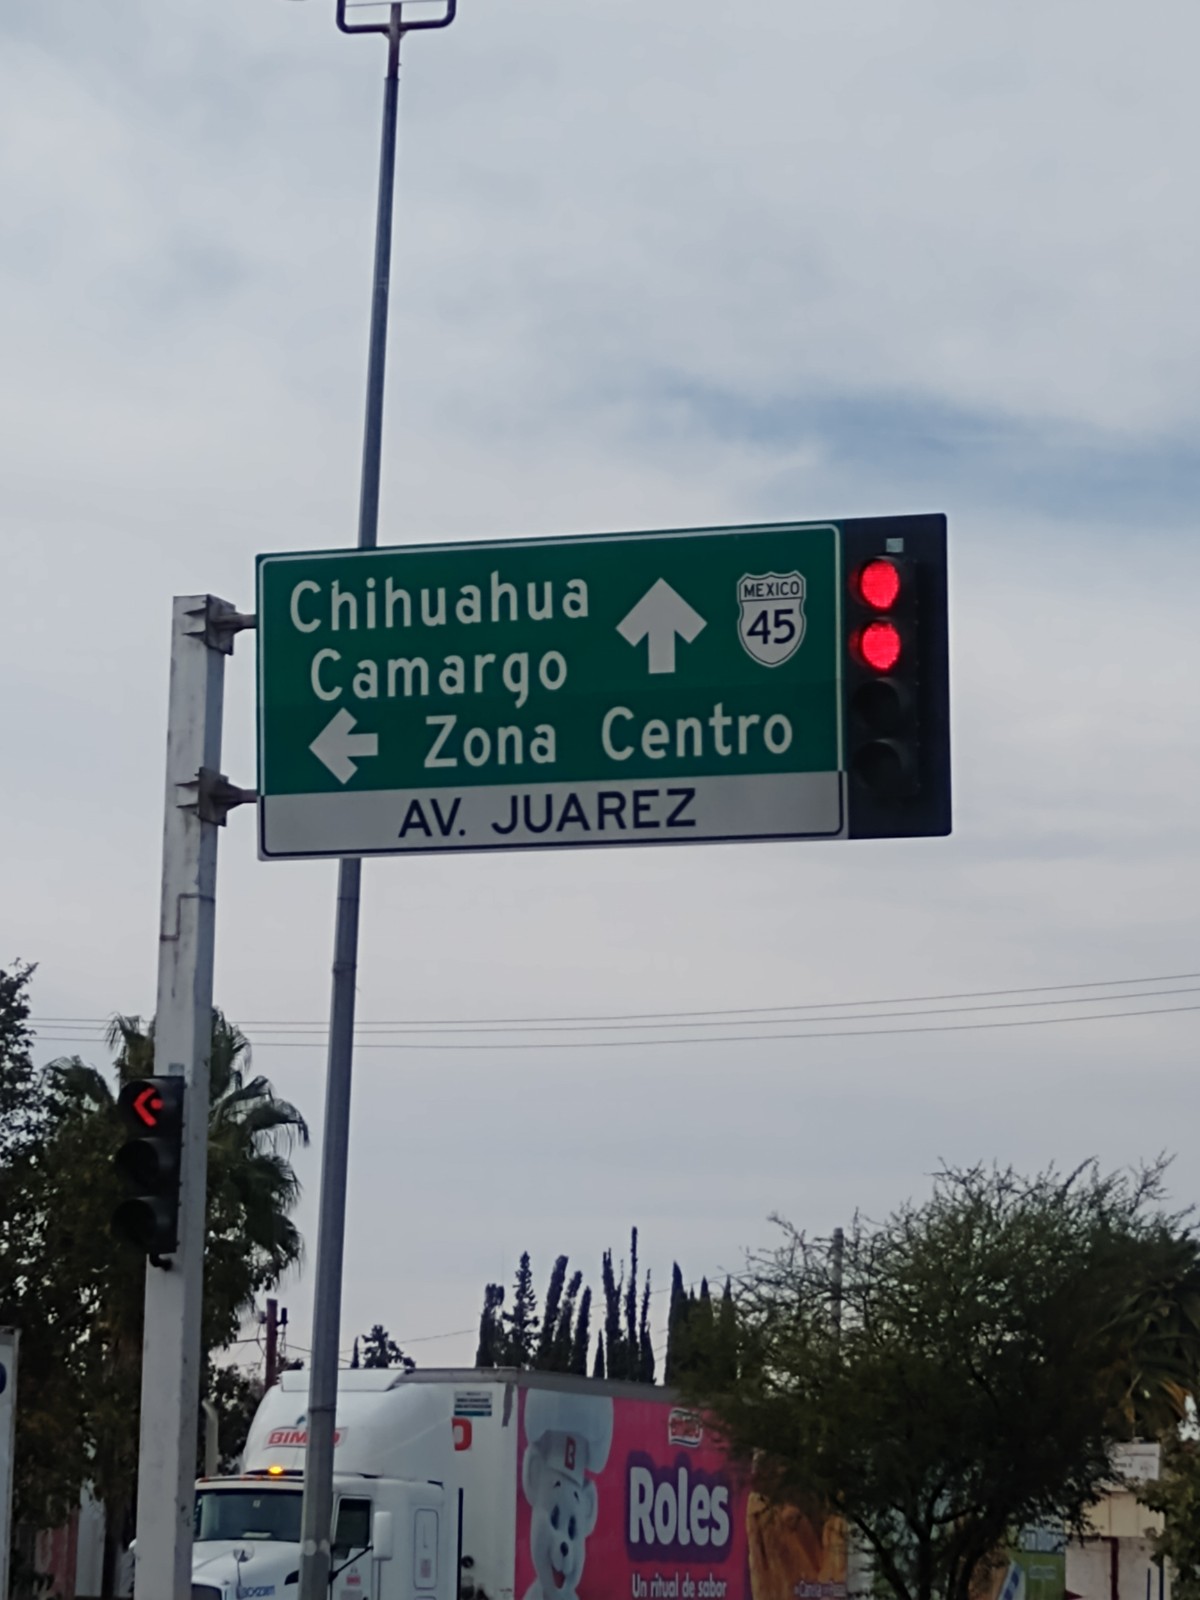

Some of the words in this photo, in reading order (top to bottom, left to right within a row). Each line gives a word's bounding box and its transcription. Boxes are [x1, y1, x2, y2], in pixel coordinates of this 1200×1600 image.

[289, 570, 590, 635] Chihuahua
[742, 579, 802, 598] MEXICO
[746, 608, 797, 646] 45
[309, 648, 568, 708] Camargo
[423, 713, 557, 769] Zona
[600, 702, 793, 763] Centro
[398, 797, 467, 839] AV.
[490, 787, 697, 834] JUAREZ
[629, 1466, 730, 1547] Roles
[632, 1574, 648, 1598] Un
[650, 1573, 678, 1598] ritual
[682, 1573, 695, 1598] de
[698, 1573, 727, 1599] sabor
